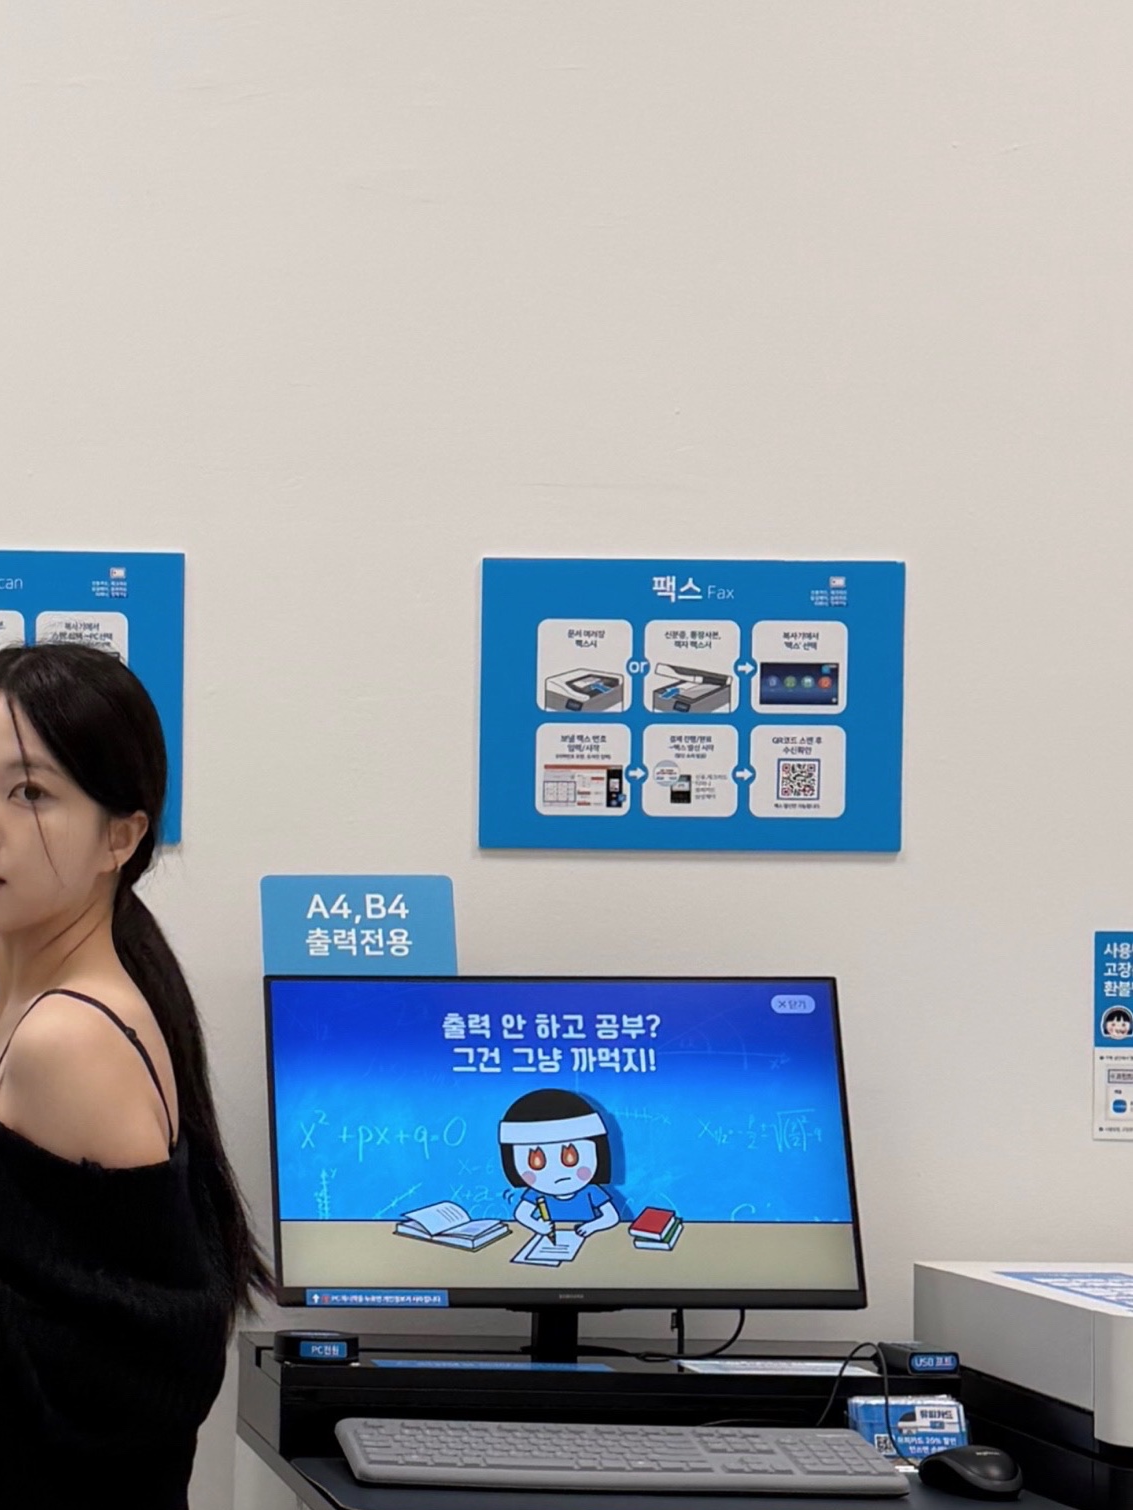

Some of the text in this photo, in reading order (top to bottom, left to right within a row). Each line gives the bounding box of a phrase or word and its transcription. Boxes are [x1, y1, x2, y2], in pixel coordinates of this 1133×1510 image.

[652, 575, 734, 603] 팩스 Fax
[568, 629, 582, 638] 문서
[629, 661, 646, 673] or
[772, 737, 797, 745] QR코드
[306, 893, 410, 925] A4,B4
[305, 927, 413, 957] 출력전용
[1103, 943, 1133, 959] 사용
[1103, 962, 1133, 978] 고장
[1103, 981, 1133, 997] 환불
[788, 1000, 807, 1010] 닫기
[442, 1013, 661, 1040] 출력 안 하고 공부?
[452, 1047, 657, 1073] 그건 그냥 까먹지!
[915, 1357, 934, 1368] USB
